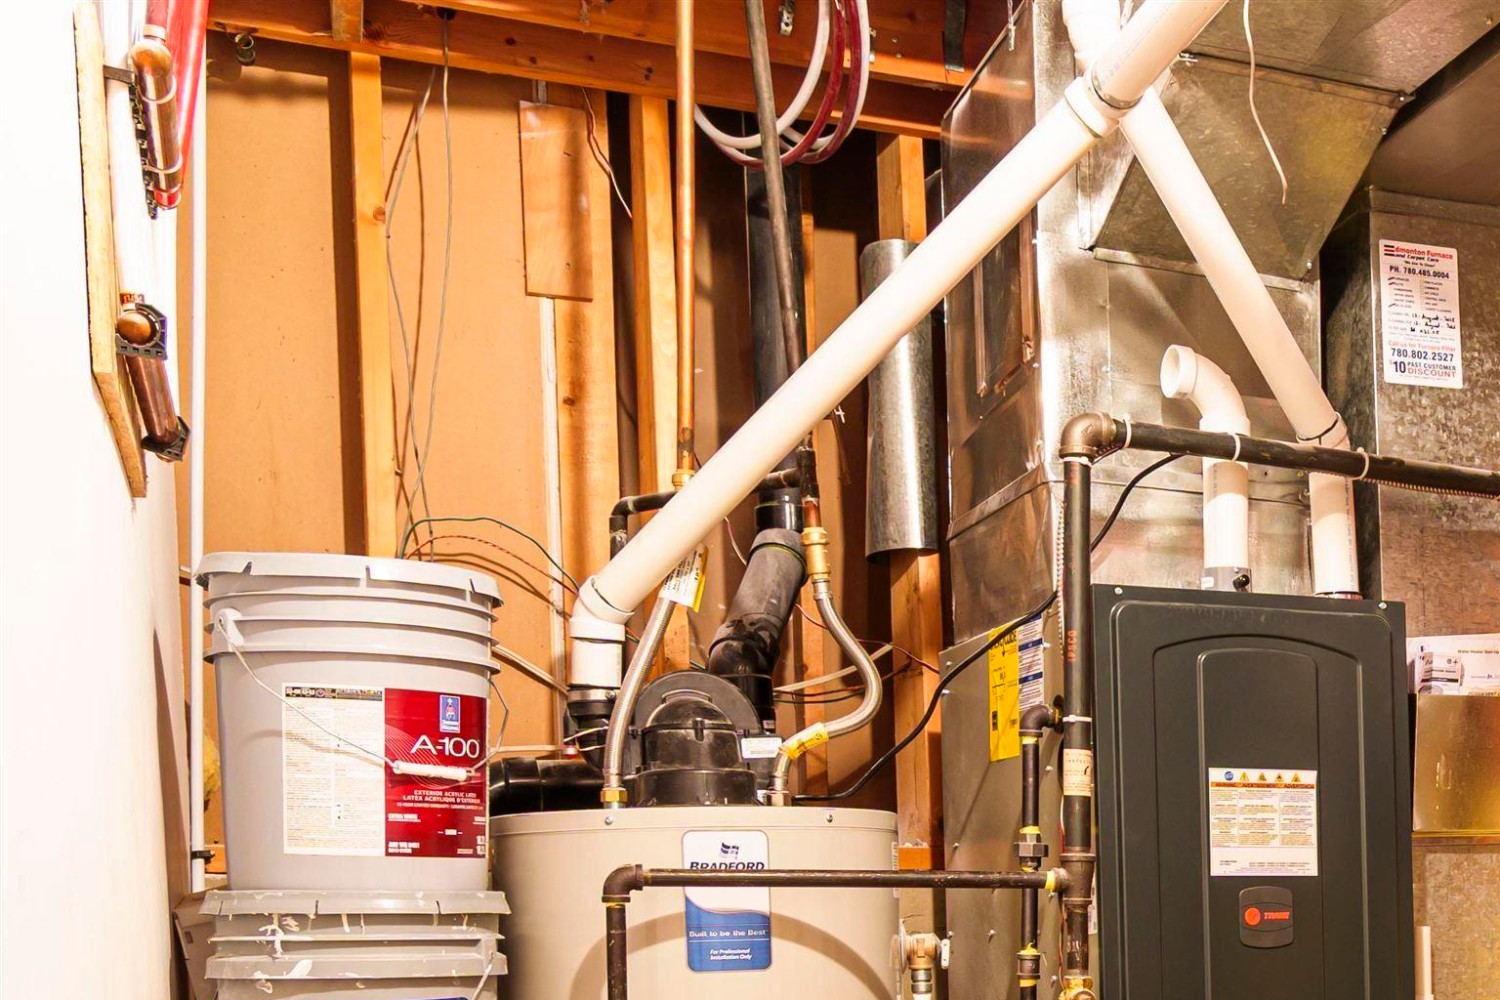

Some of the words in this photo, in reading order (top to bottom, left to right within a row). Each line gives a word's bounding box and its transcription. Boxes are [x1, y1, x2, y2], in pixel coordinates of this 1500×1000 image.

[1426, 250, 1453, 260] Furnace
[1389, 265, 1402, 273] PH.
[1390, 347, 1454, 362] 780.802.2527
[1423, 363, 1456, 371] CUSTOMER
[1407, 368, 1457, 378] DISCOUNT
[410, 735, 480, 759] A-100
